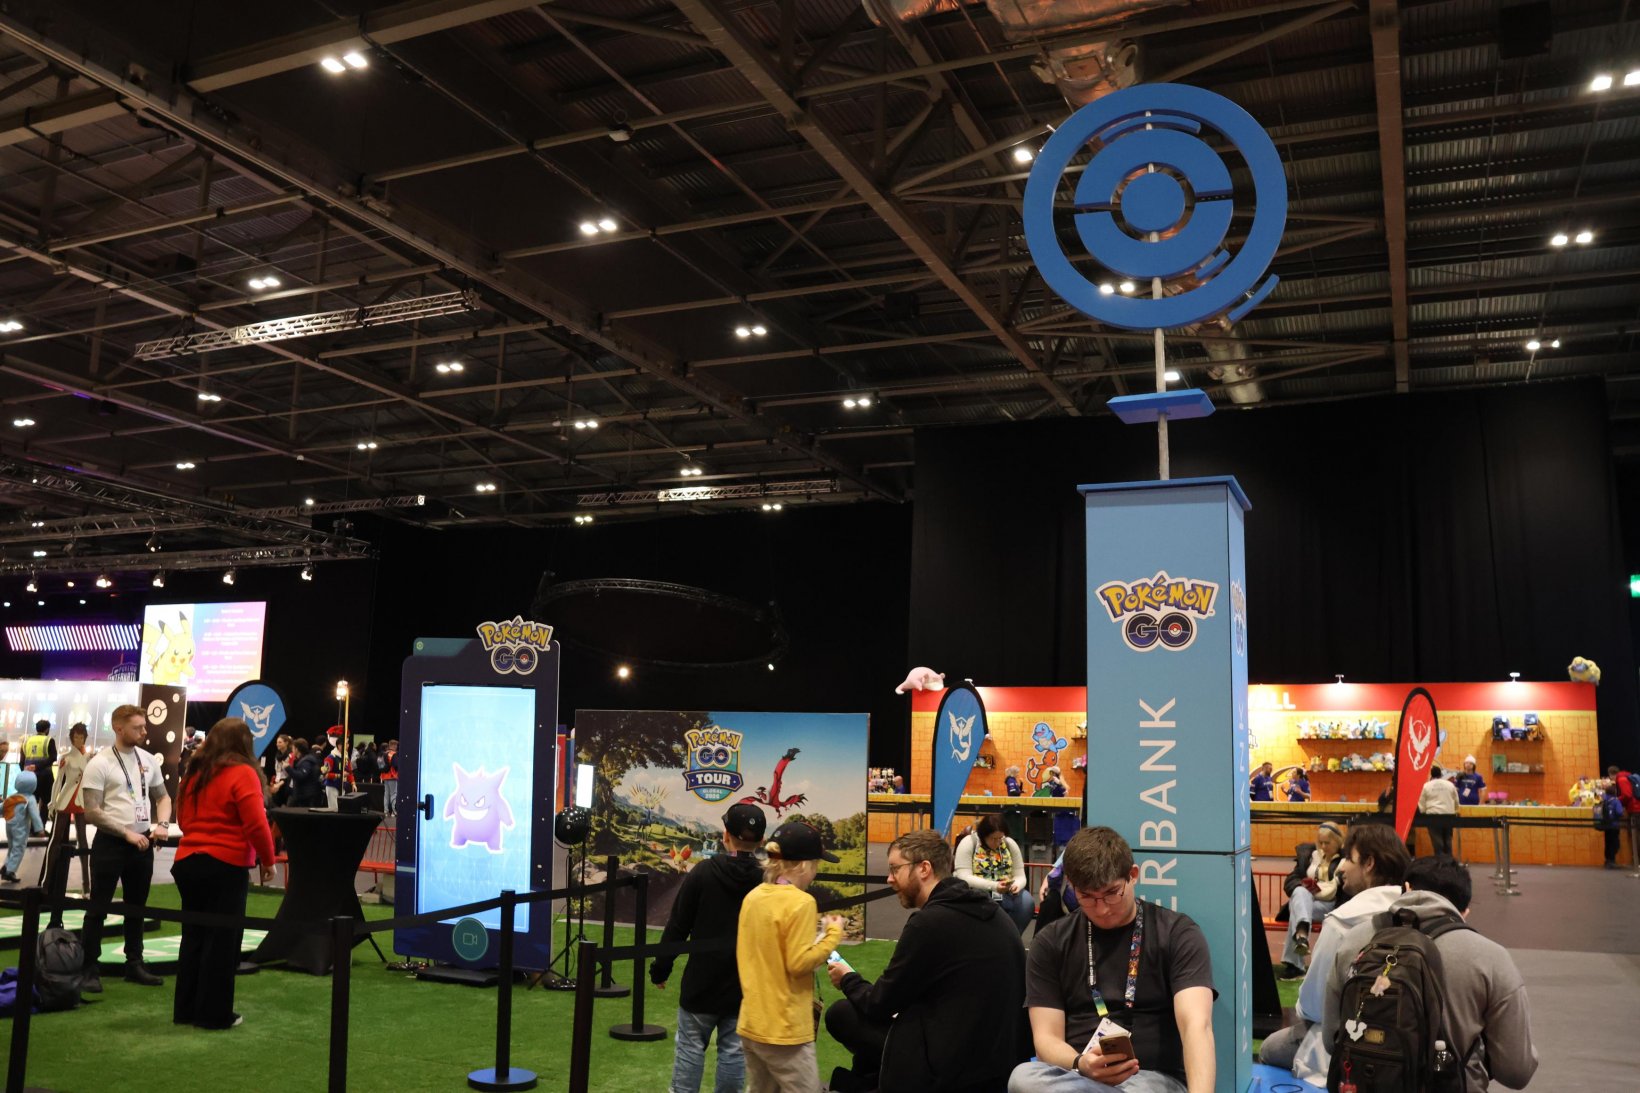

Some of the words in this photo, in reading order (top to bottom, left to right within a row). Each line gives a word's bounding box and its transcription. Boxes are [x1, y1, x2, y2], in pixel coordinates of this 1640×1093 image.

[1125, 612, 1194, 649] GO
[493, 645, 536, 673] GO
[698, 746, 730, 766] GO
[695, 773, 732, 786] TOUR
[1139, 697, 1177, 912] ERBANK
